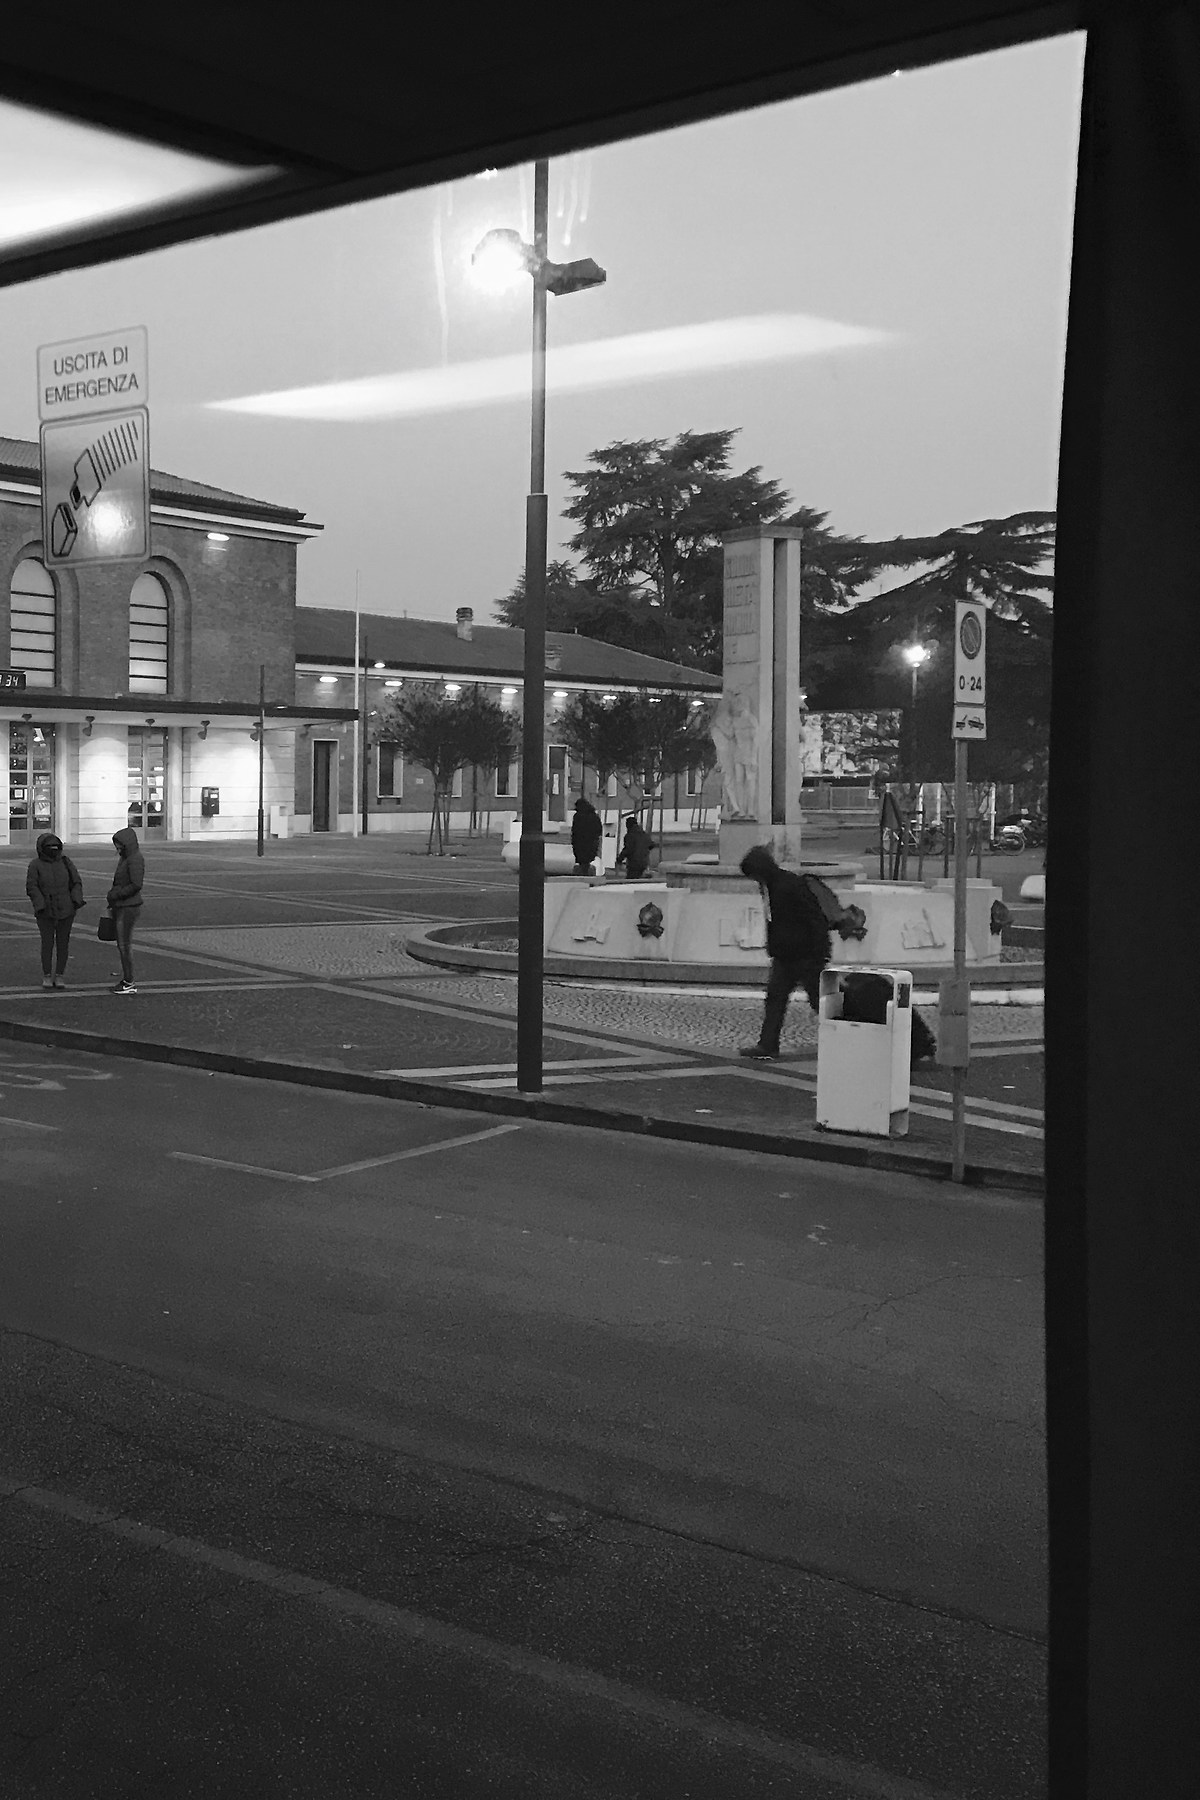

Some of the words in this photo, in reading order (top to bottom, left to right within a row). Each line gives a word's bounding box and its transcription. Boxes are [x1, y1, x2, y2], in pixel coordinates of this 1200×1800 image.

[54, 350, 108, 376] USCITA
[113, 346, 129, 365] DI
[45, 373, 139, 405] EMERGENZA
